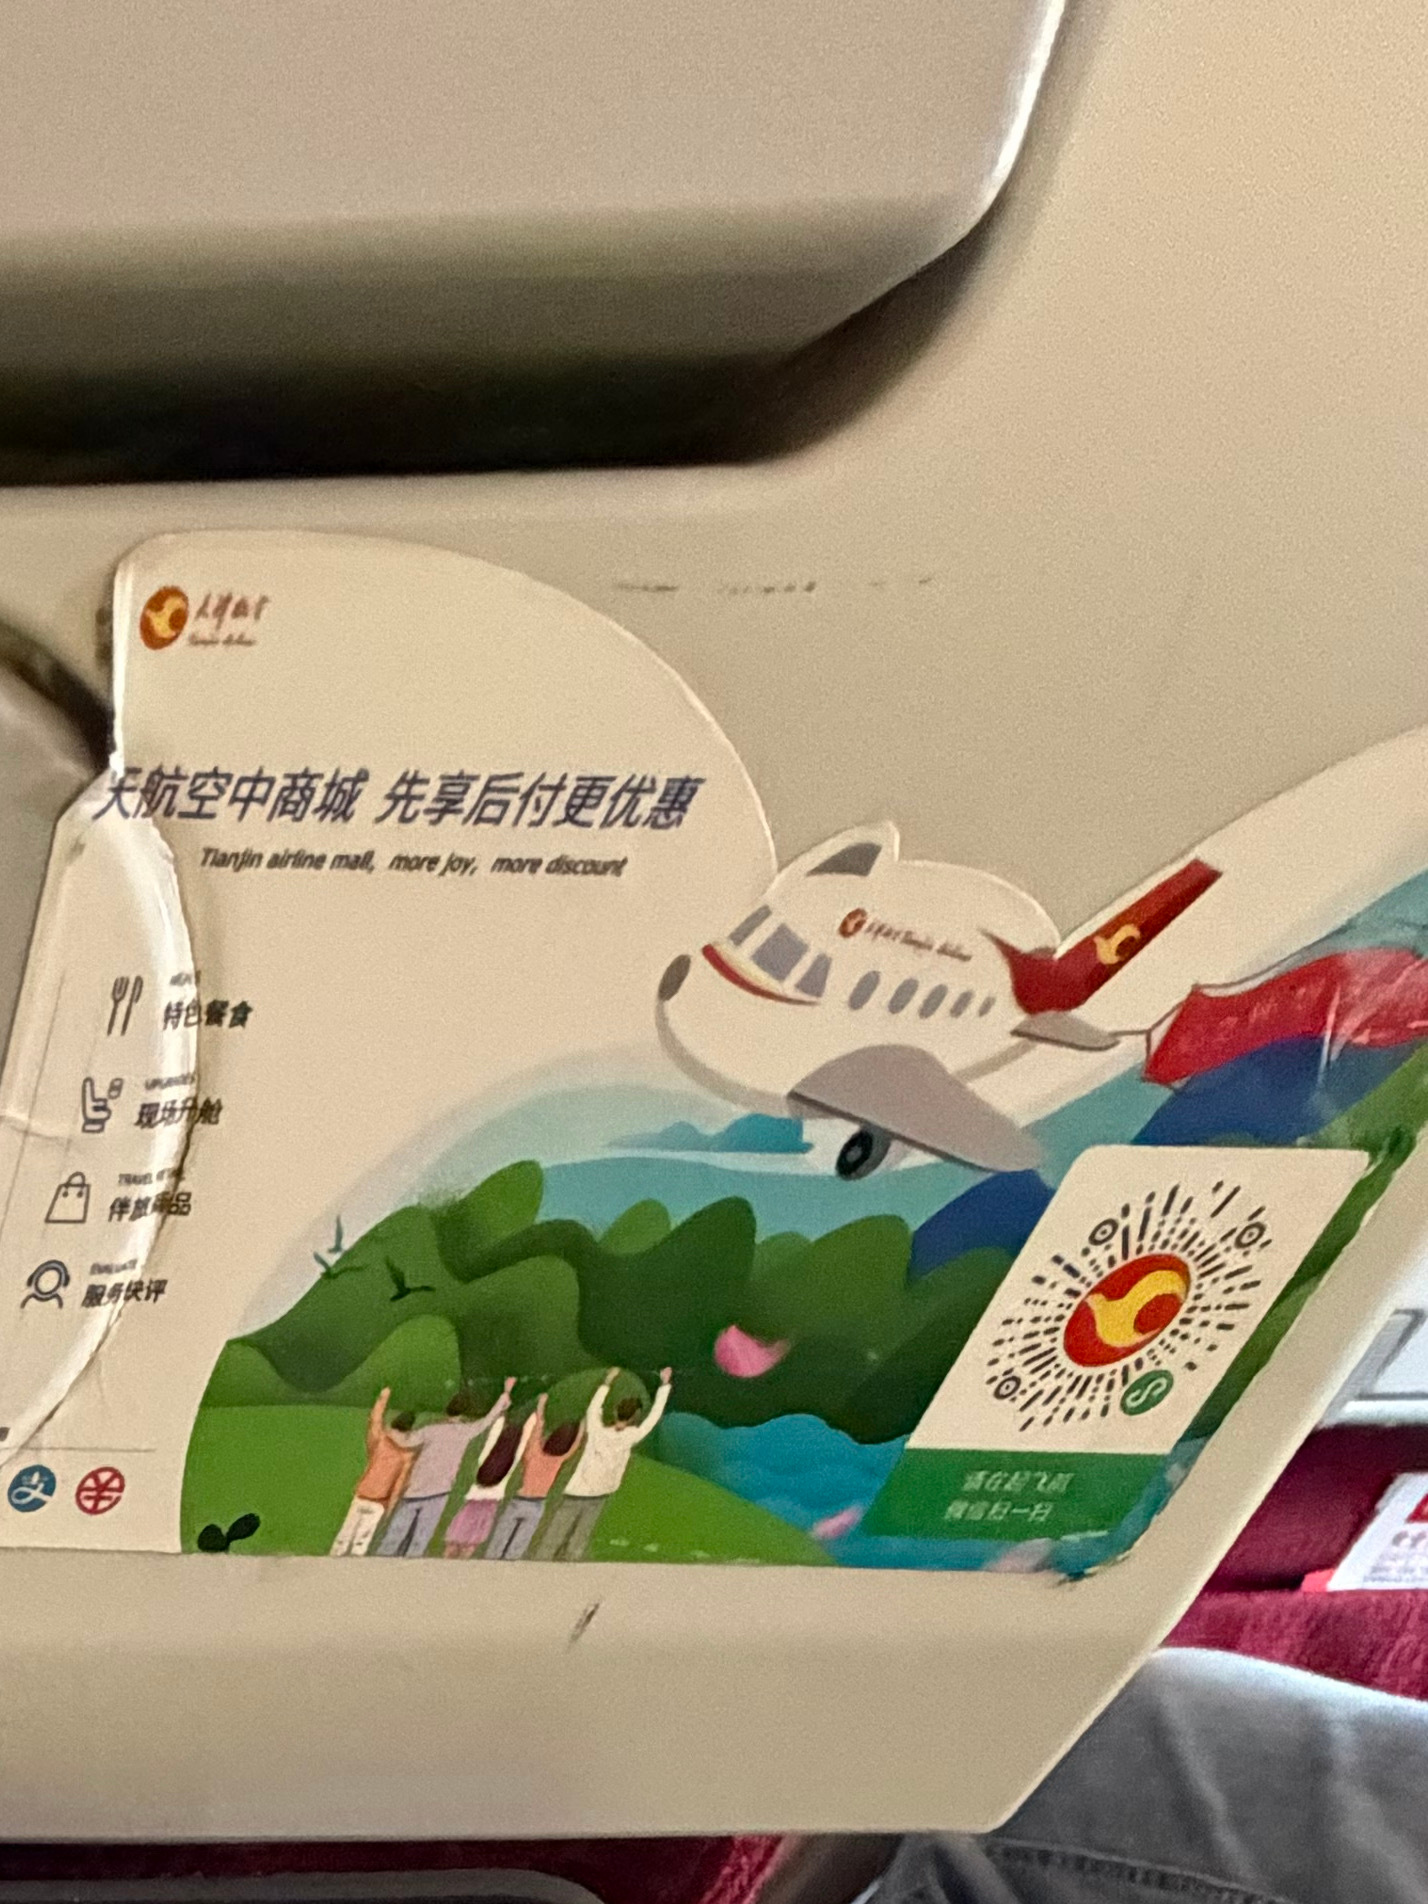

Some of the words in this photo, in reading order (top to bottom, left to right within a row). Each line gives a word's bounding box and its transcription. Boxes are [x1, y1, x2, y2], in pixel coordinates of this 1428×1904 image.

[374, 769, 707, 830] 先享后付更优惠
[200, 847, 263, 873] Tianjin
[266, 849, 327, 870] airline
[389, 854, 441, 873] more
[490, 856, 544, 875] more
[545, 854, 629, 877] discount
